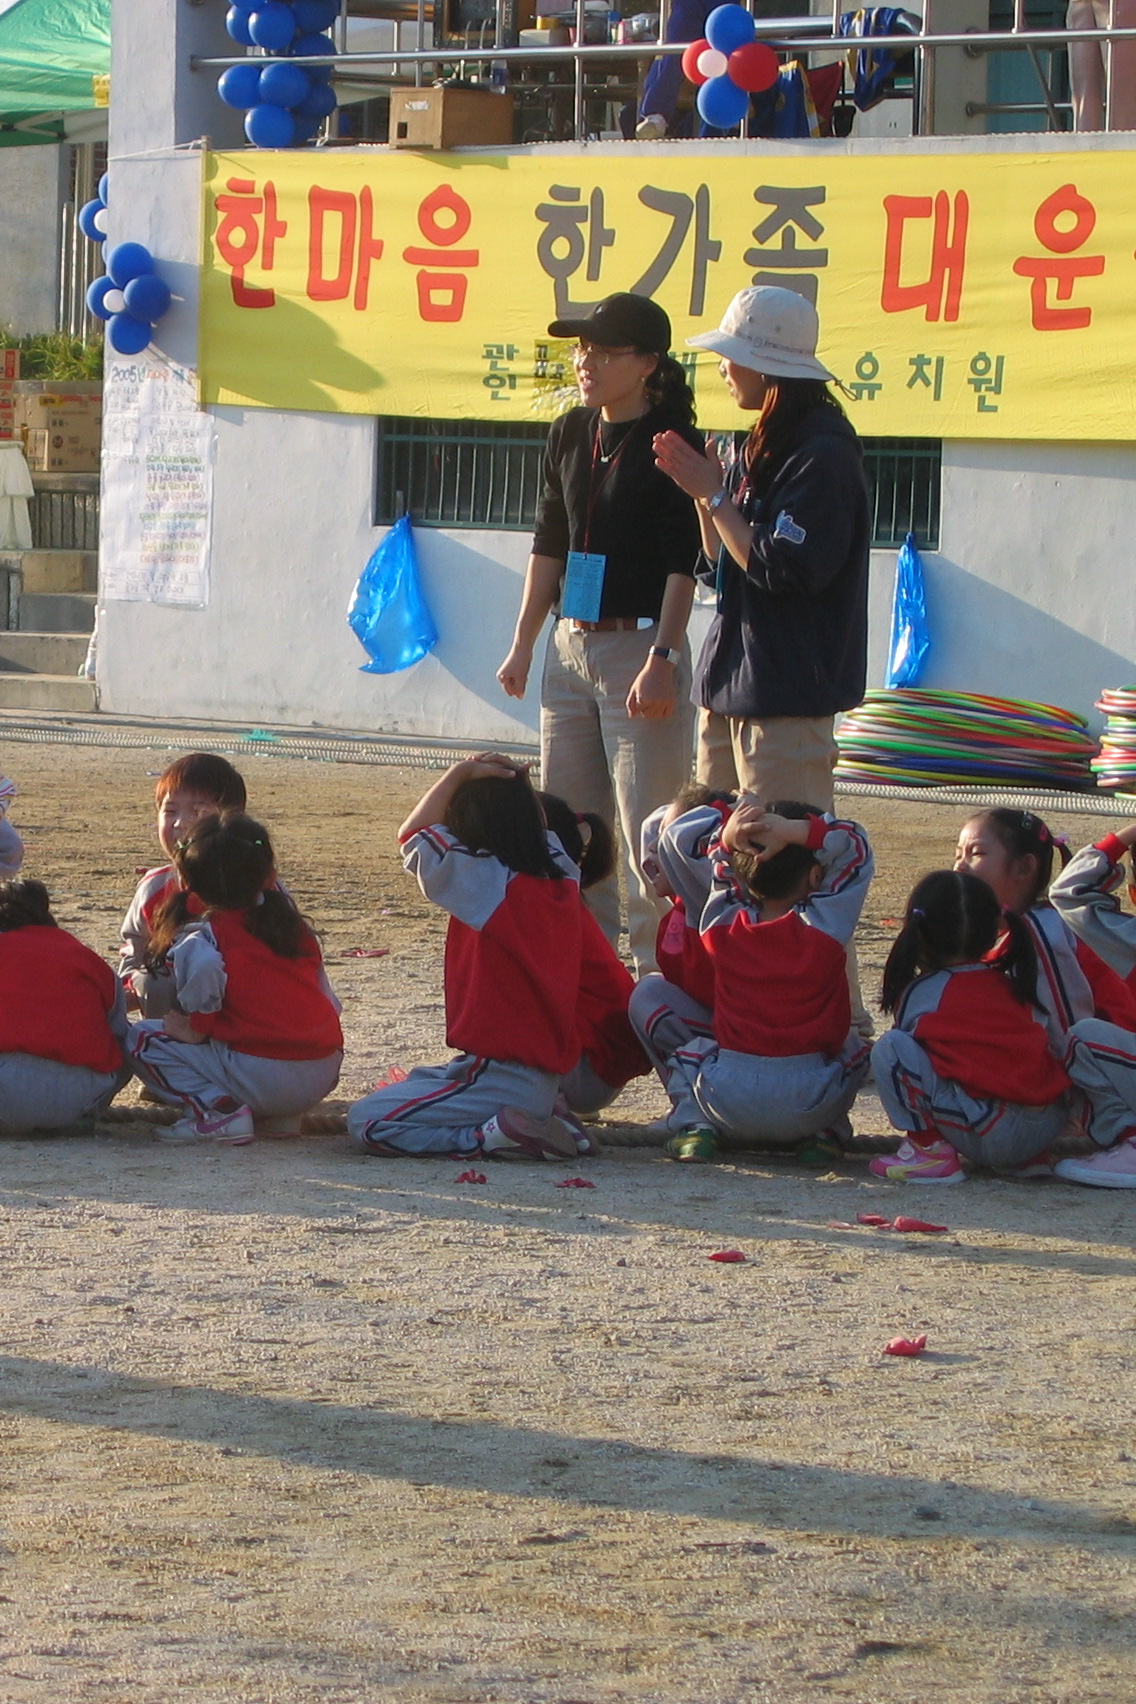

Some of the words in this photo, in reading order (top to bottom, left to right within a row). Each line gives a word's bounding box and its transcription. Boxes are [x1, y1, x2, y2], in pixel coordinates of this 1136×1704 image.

[214, 176, 480, 323] 한마음
[534, 183, 829, 321] 한가족
[880, 183, 1136, 332] 대운
[849, 351, 1005, 413] 유치원
